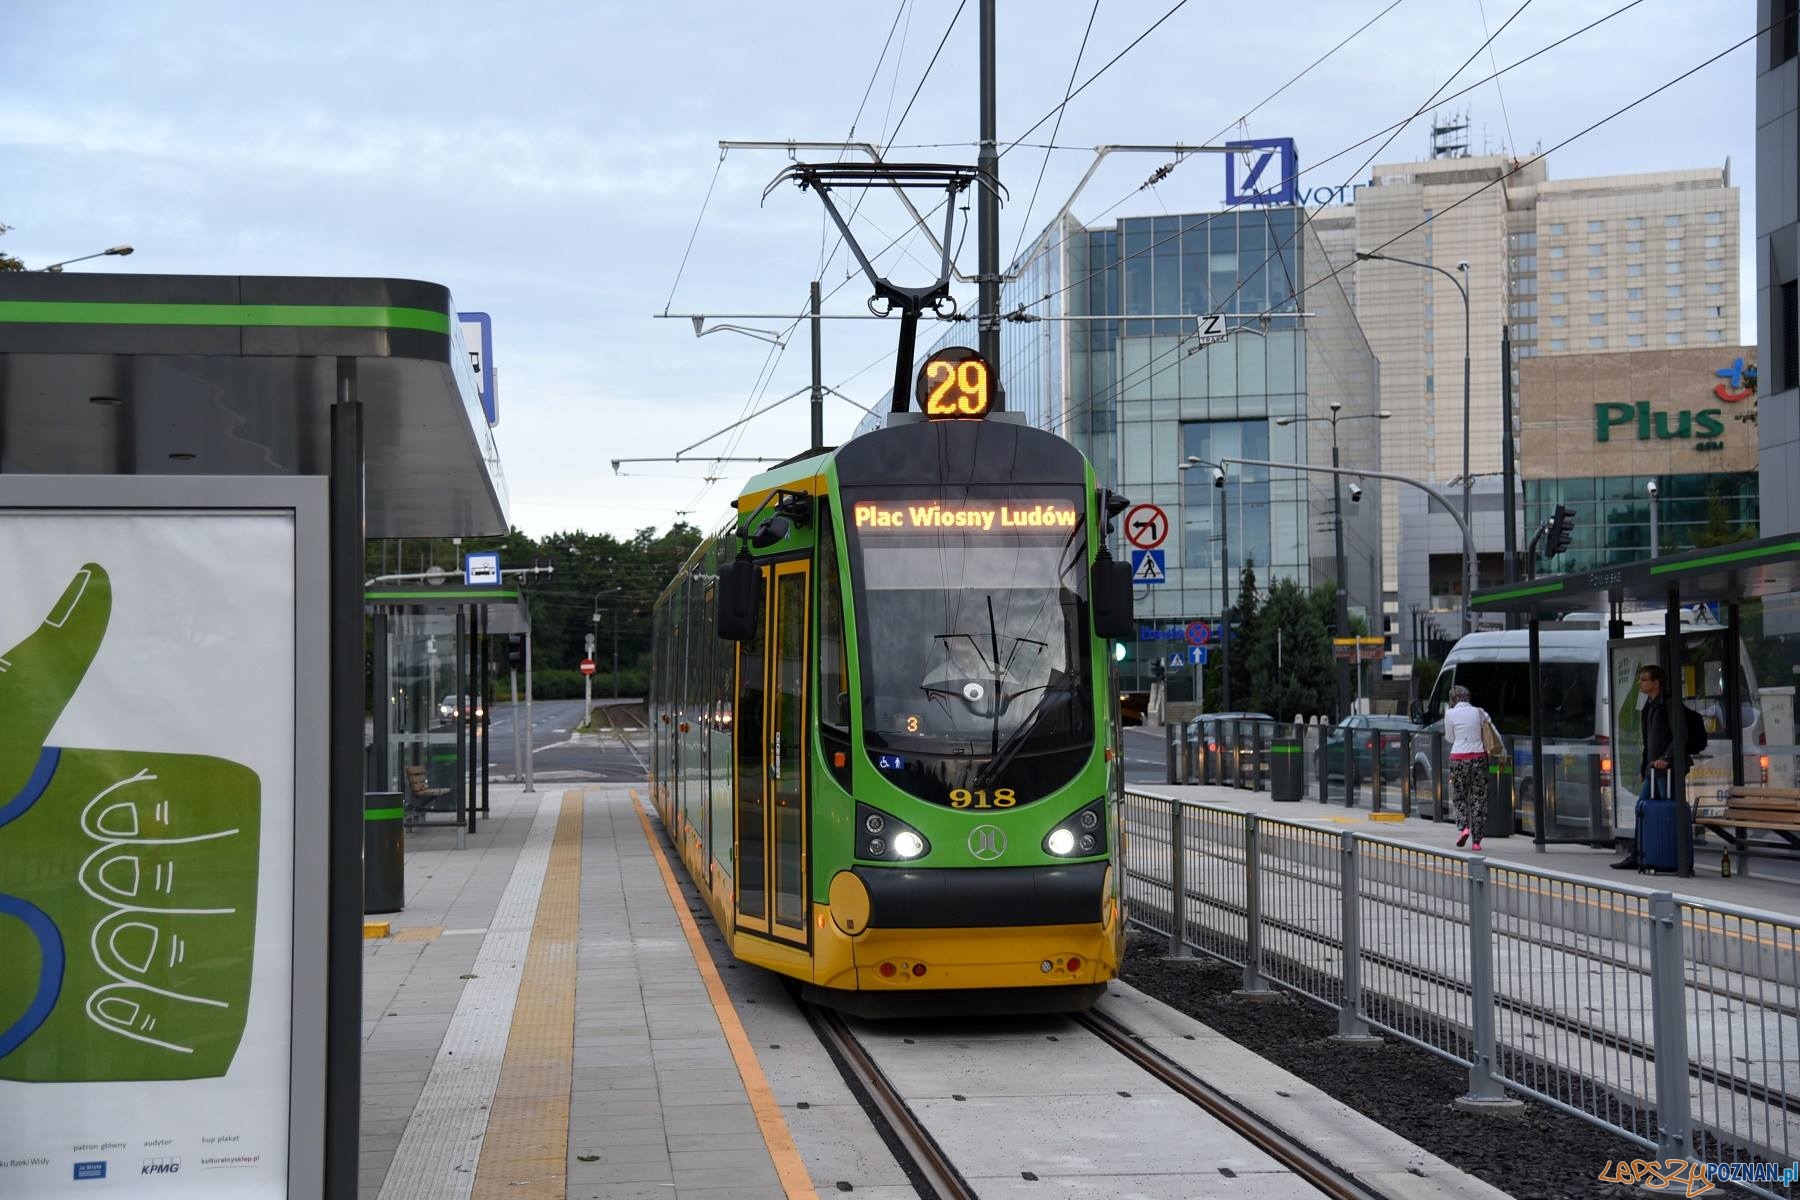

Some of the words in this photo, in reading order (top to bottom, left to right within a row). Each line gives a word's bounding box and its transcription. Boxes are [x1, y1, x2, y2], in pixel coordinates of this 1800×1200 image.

[1202, 315, 1221, 335] Z
[927, 361, 987, 414] 29
[1595, 401, 1724, 442] Plus
[855, 506, 903, 527] Plac
[909, 505, 995, 530] Wiosny
[1001, 505, 1076, 527] Ludów
[907, 716, 918, 731] 3
[949, 788, 1017, 809] 918
[73, 1144, 99, 1152] patron
[143, 1139, 173, 1148] audytor
[217, 1135, 239, 1144] plakat
[141, 1163, 179, 1175] KPMG
